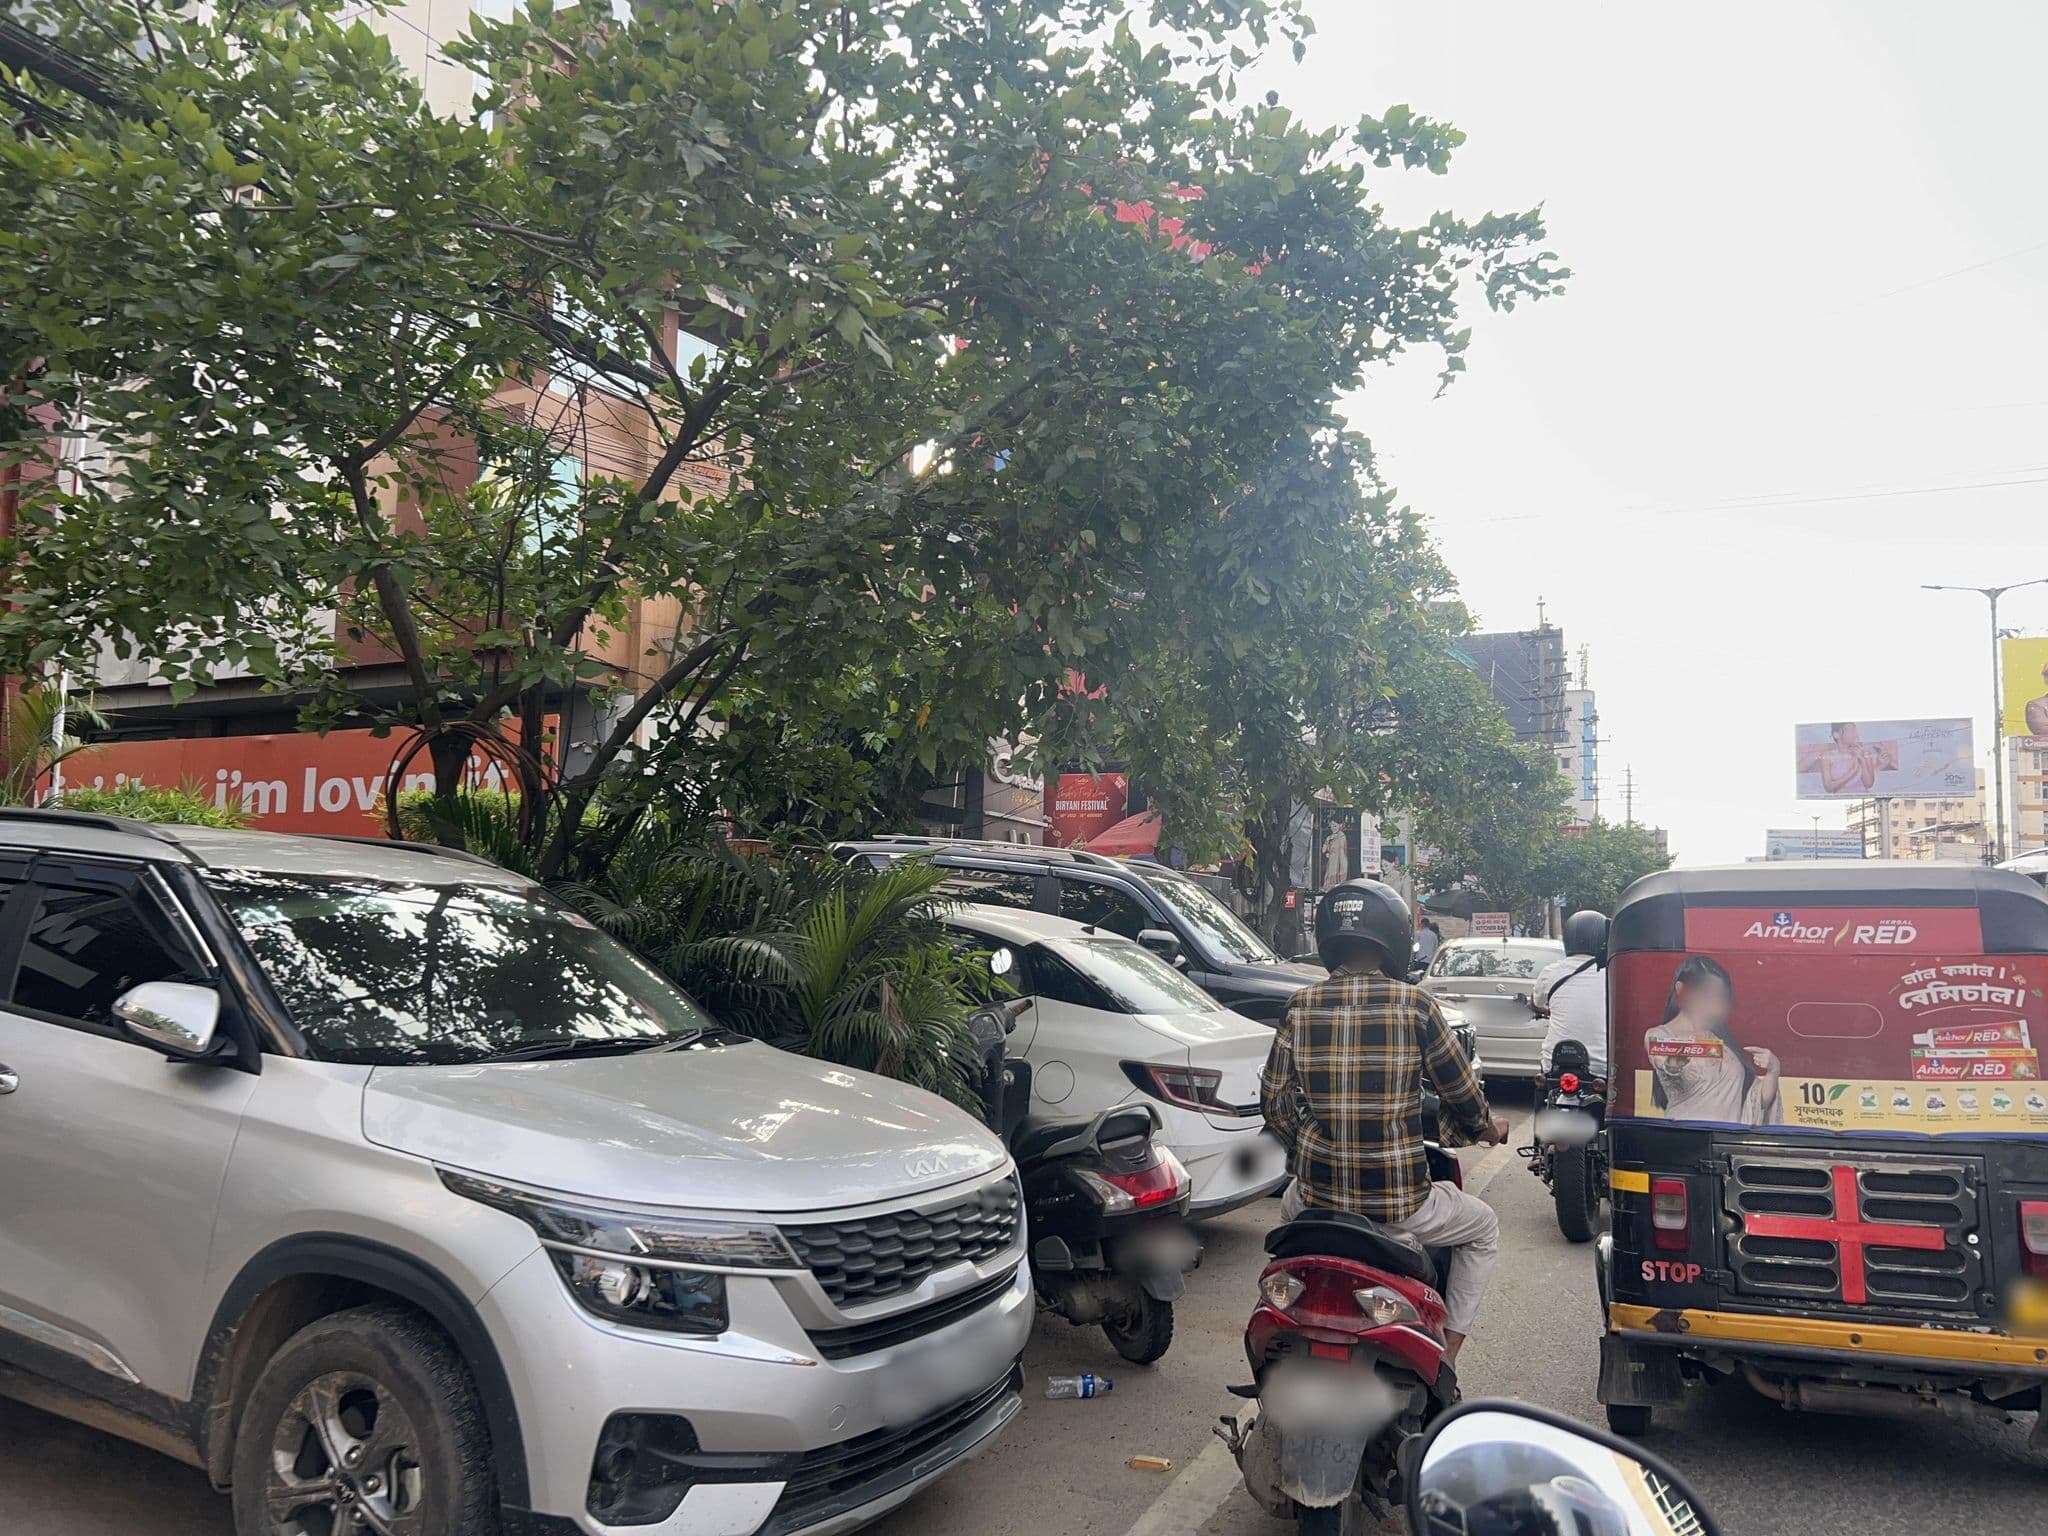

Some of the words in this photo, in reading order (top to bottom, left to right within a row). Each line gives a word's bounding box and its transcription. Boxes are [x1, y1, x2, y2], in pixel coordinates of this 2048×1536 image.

[214, 769, 288, 814] i'm
[1055, 800, 1080, 811] BIRYANI
[1081, 800, 1108, 811] FESTIVAL
[1743, 921, 1833, 938] Anchor
[1852, 925, 1917, 945] RED
[1901, 967, 1937, 985] লাল
[1935, 1033, 1967, 1042] Anchor
[1973, 1031, 2001, 1042] RED
[1683, 1046, 1704, 1055] RED
[1916, 1063, 1961, 1075] Anchor
[1972, 1063, 2006, 1076] RED
[1799, 1082, 1825, 1105] 10
[1641, 1260, 1701, 1284] STOP
